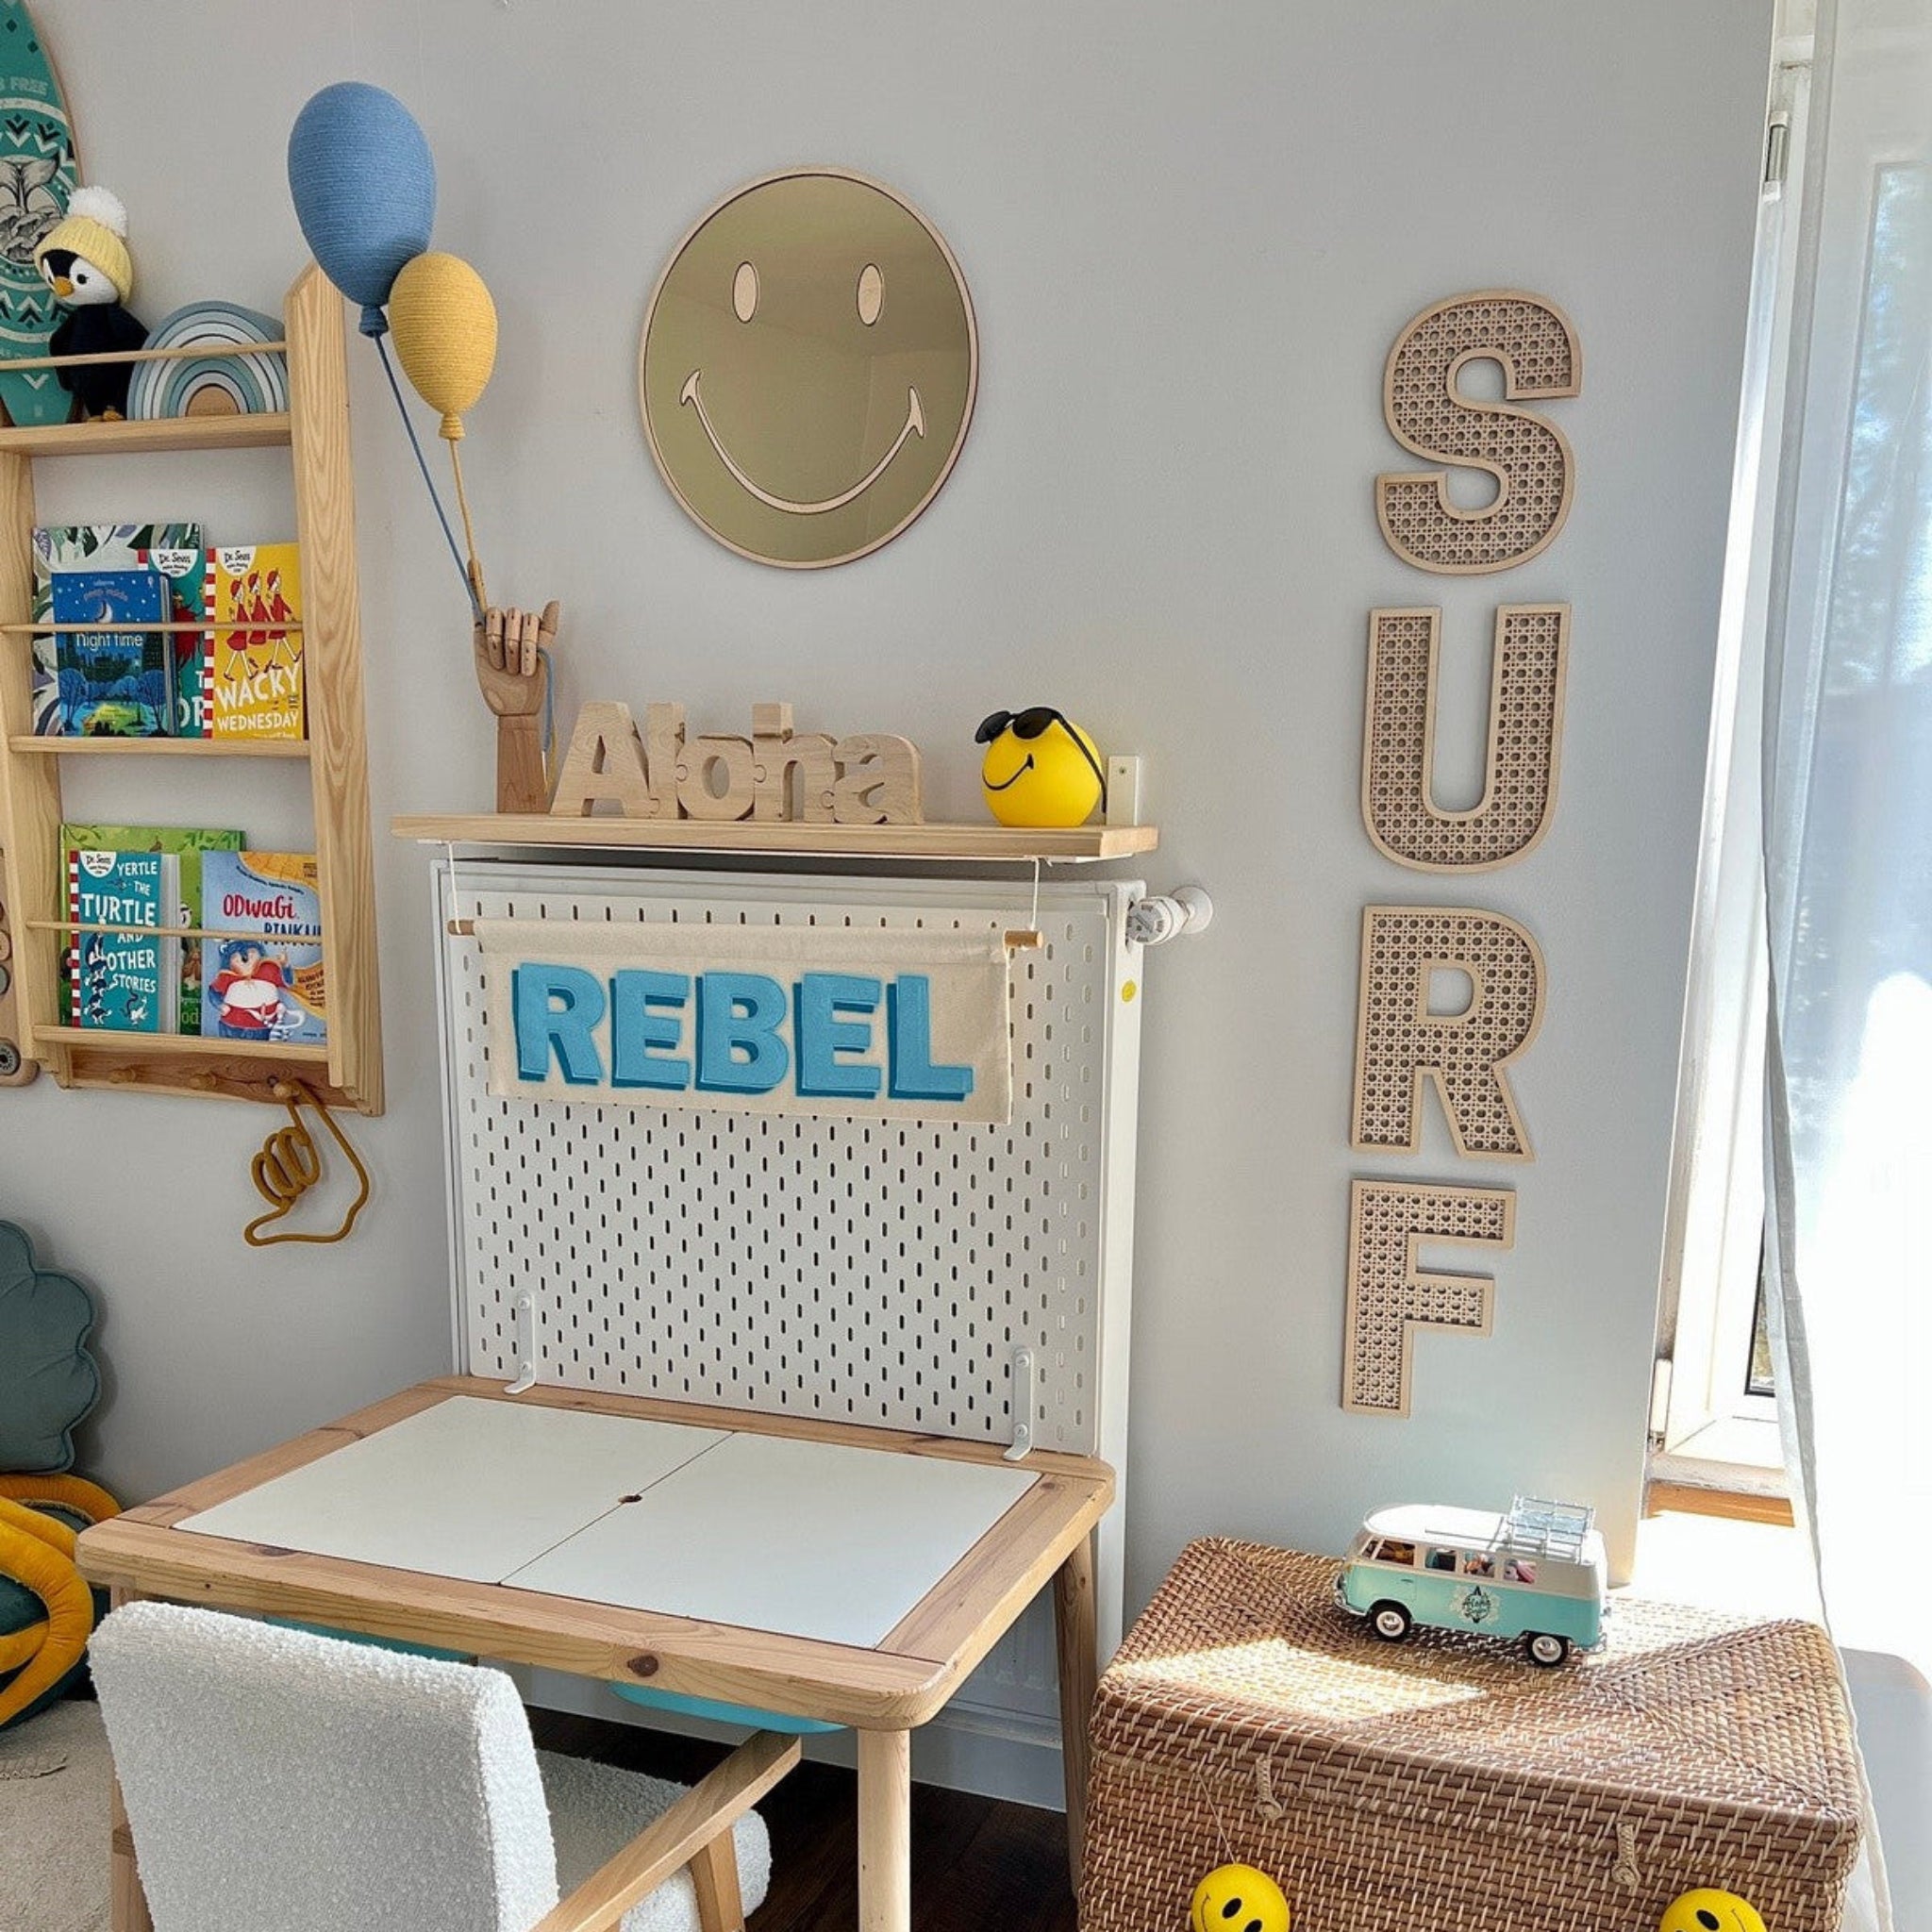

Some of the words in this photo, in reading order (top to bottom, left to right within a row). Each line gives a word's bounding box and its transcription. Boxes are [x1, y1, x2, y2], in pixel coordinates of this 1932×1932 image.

[10, 76, 48, 95] FREE
[215, 662, 300, 713] WACKY
[217, 709, 299, 732] WEDNESDAY
[550, 701, 925, 826] Aloha
[1341, 289, 1582, 1419] SURF
[117, 860, 158, 877] YERTLE
[134, 879, 151, 897] THE
[81, 892, 156, 926] TURTLE
[107, 949, 156, 971] OTHER
[112, 973, 157, 992] STORIES
[512, 961, 974, 1102] REBEL
